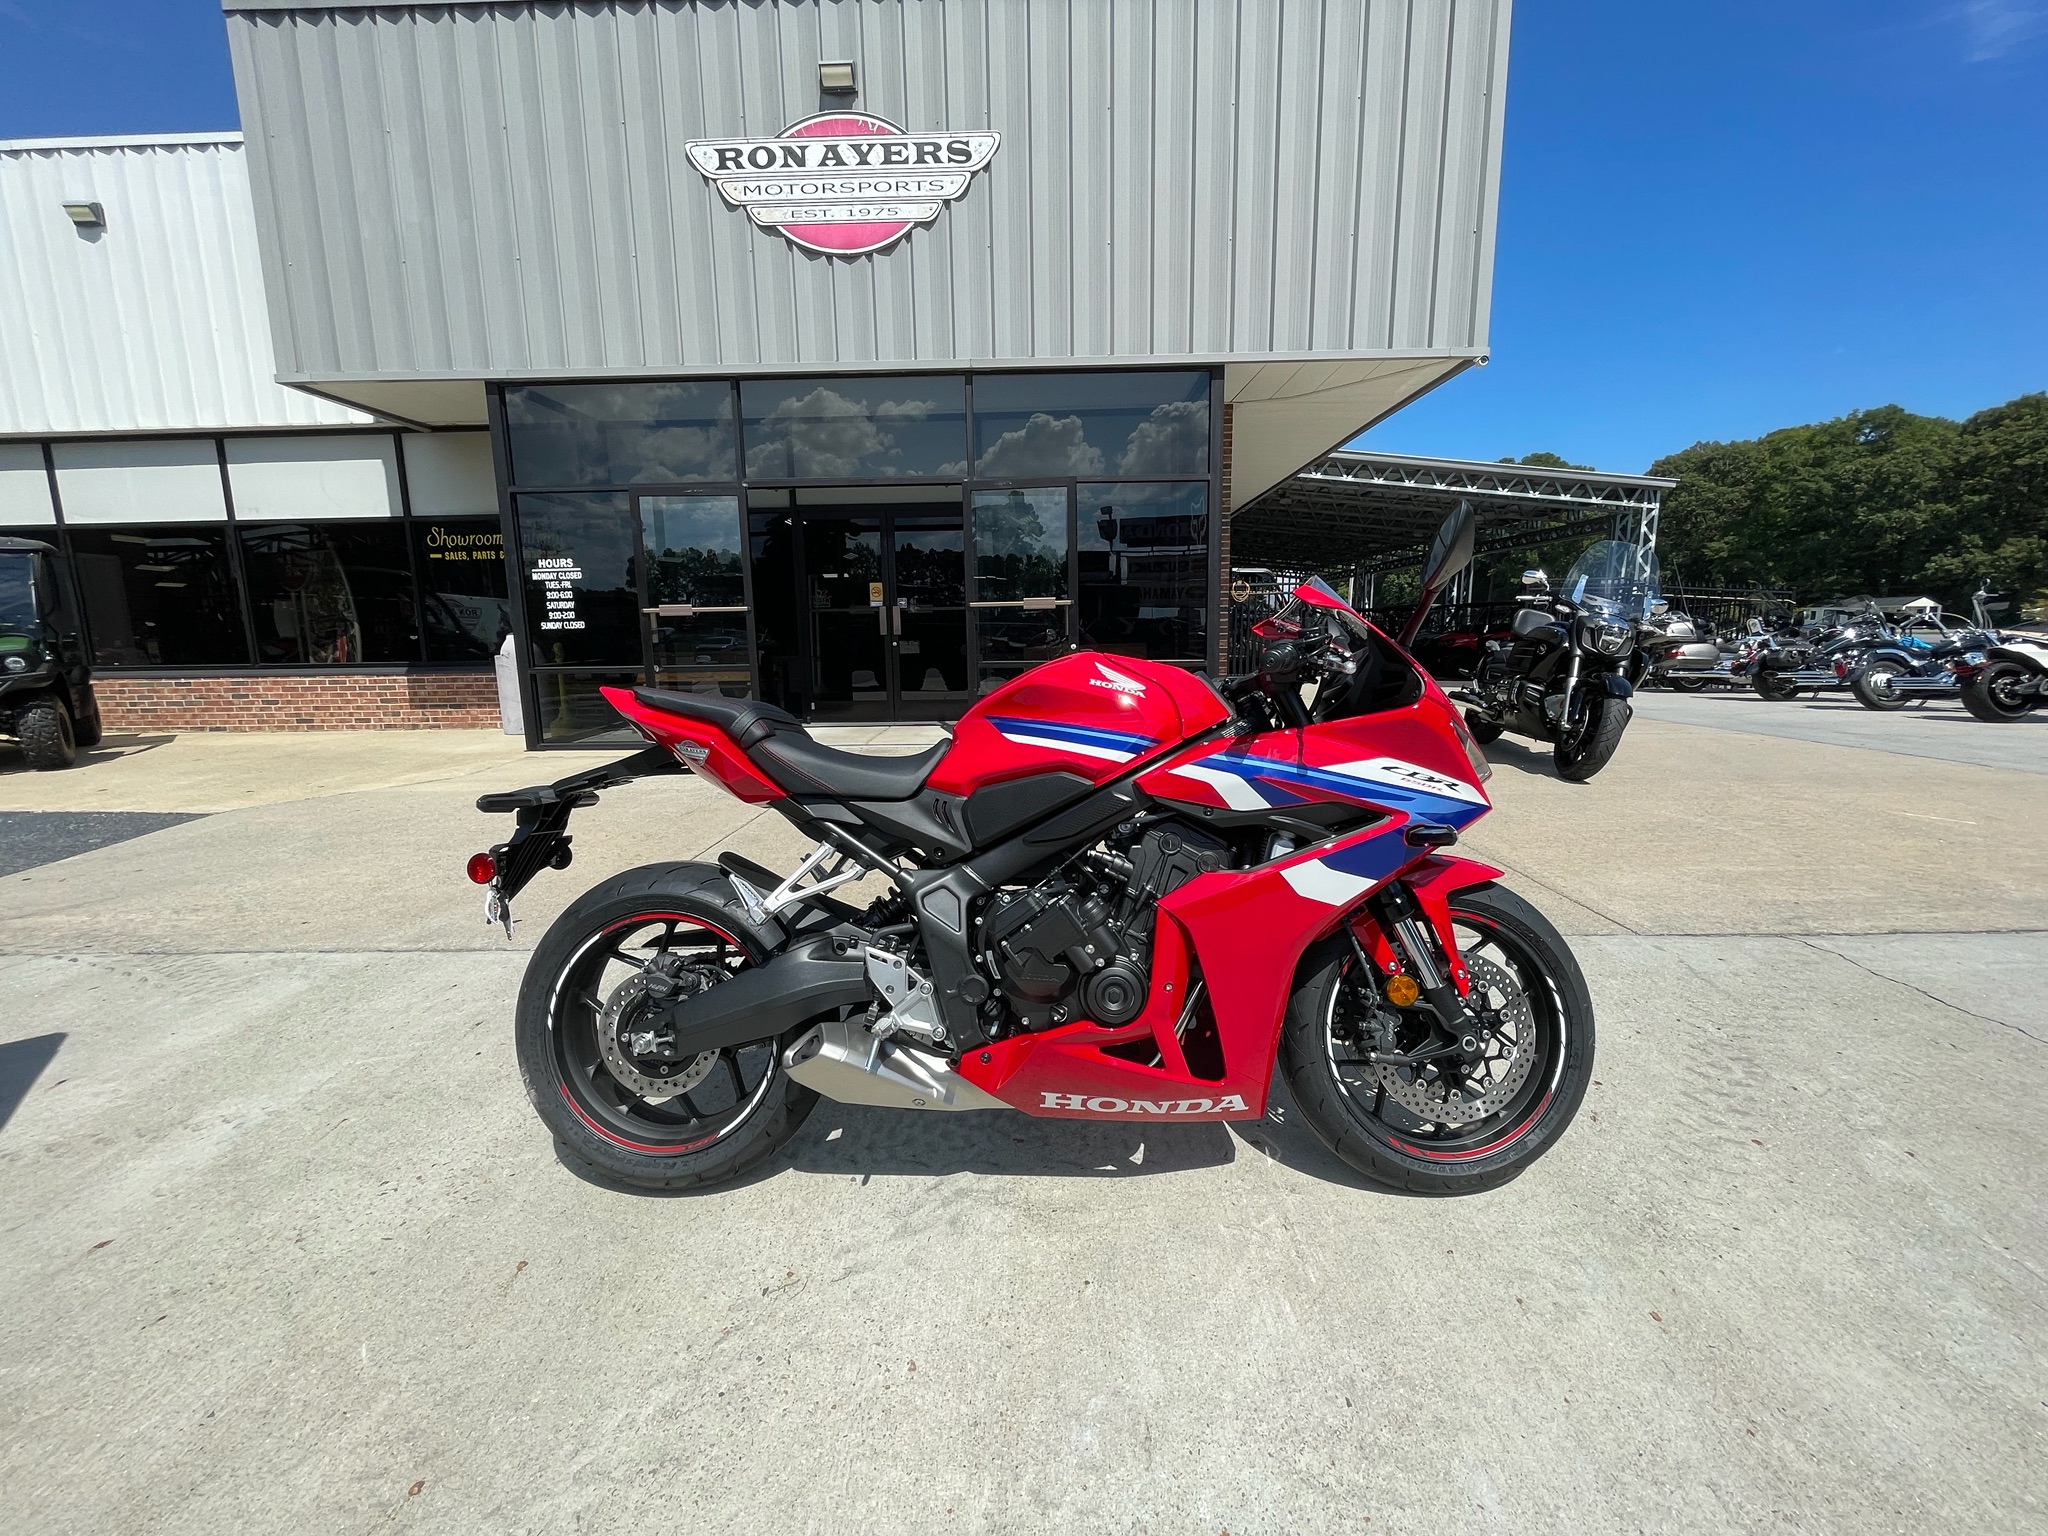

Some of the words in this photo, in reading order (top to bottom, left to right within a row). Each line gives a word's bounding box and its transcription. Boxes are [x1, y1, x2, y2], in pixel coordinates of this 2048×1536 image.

[713, 145, 807, 171] RON
[816, 140, 973, 166] AYERS
[743, 179, 944, 197] MOTORSPORTS
[791, 209, 836, 219] EST.
[847, 206, 899, 217] 1975
[427, 526, 504, 548] Showroom
[444, 551, 469, 560] SALES,
[472, 551, 495, 560] PARTS
[538, 558, 573, 568] HOURS
[532, 572, 557, 580] MONDAY
[558, 572, 582, 580] CLOSED
[546, 591, 573, 599] 9:00-6:00
[546, 601, 575, 609] SATURDAY
[549, 611, 575, 619] 9:00-2:00
[541, 622, 562, 630] SUNDAY
[564, 621, 585, 629] CLOSED
[1089, 678, 1146, 698] HONDA
[1380, 766, 1462, 794] CBR
[1040, 1092, 1249, 1114] HONDA
